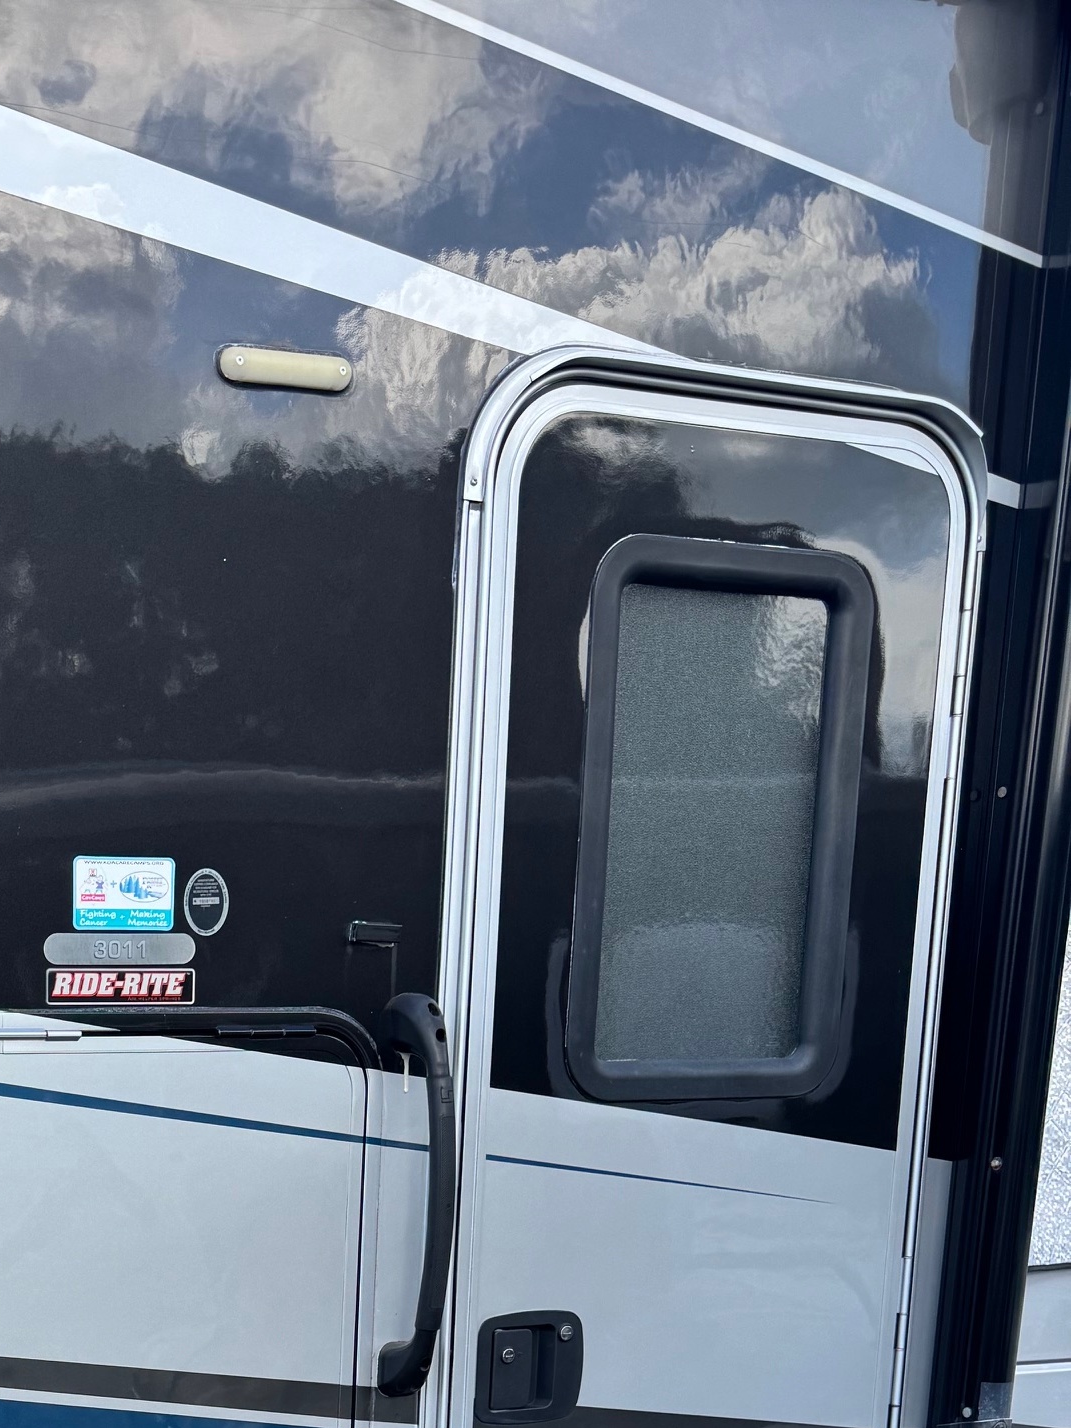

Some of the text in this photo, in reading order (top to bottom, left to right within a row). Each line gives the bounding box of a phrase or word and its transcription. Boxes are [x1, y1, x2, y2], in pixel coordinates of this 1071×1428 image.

[80, 909, 117, 919] Fighting
[130, 909, 166, 920] Making
[79, 918, 169, 927] Cancer Memories
[94, 940, 147, 960] 3011
[51, 972, 187, 998] RIDE-RITE
